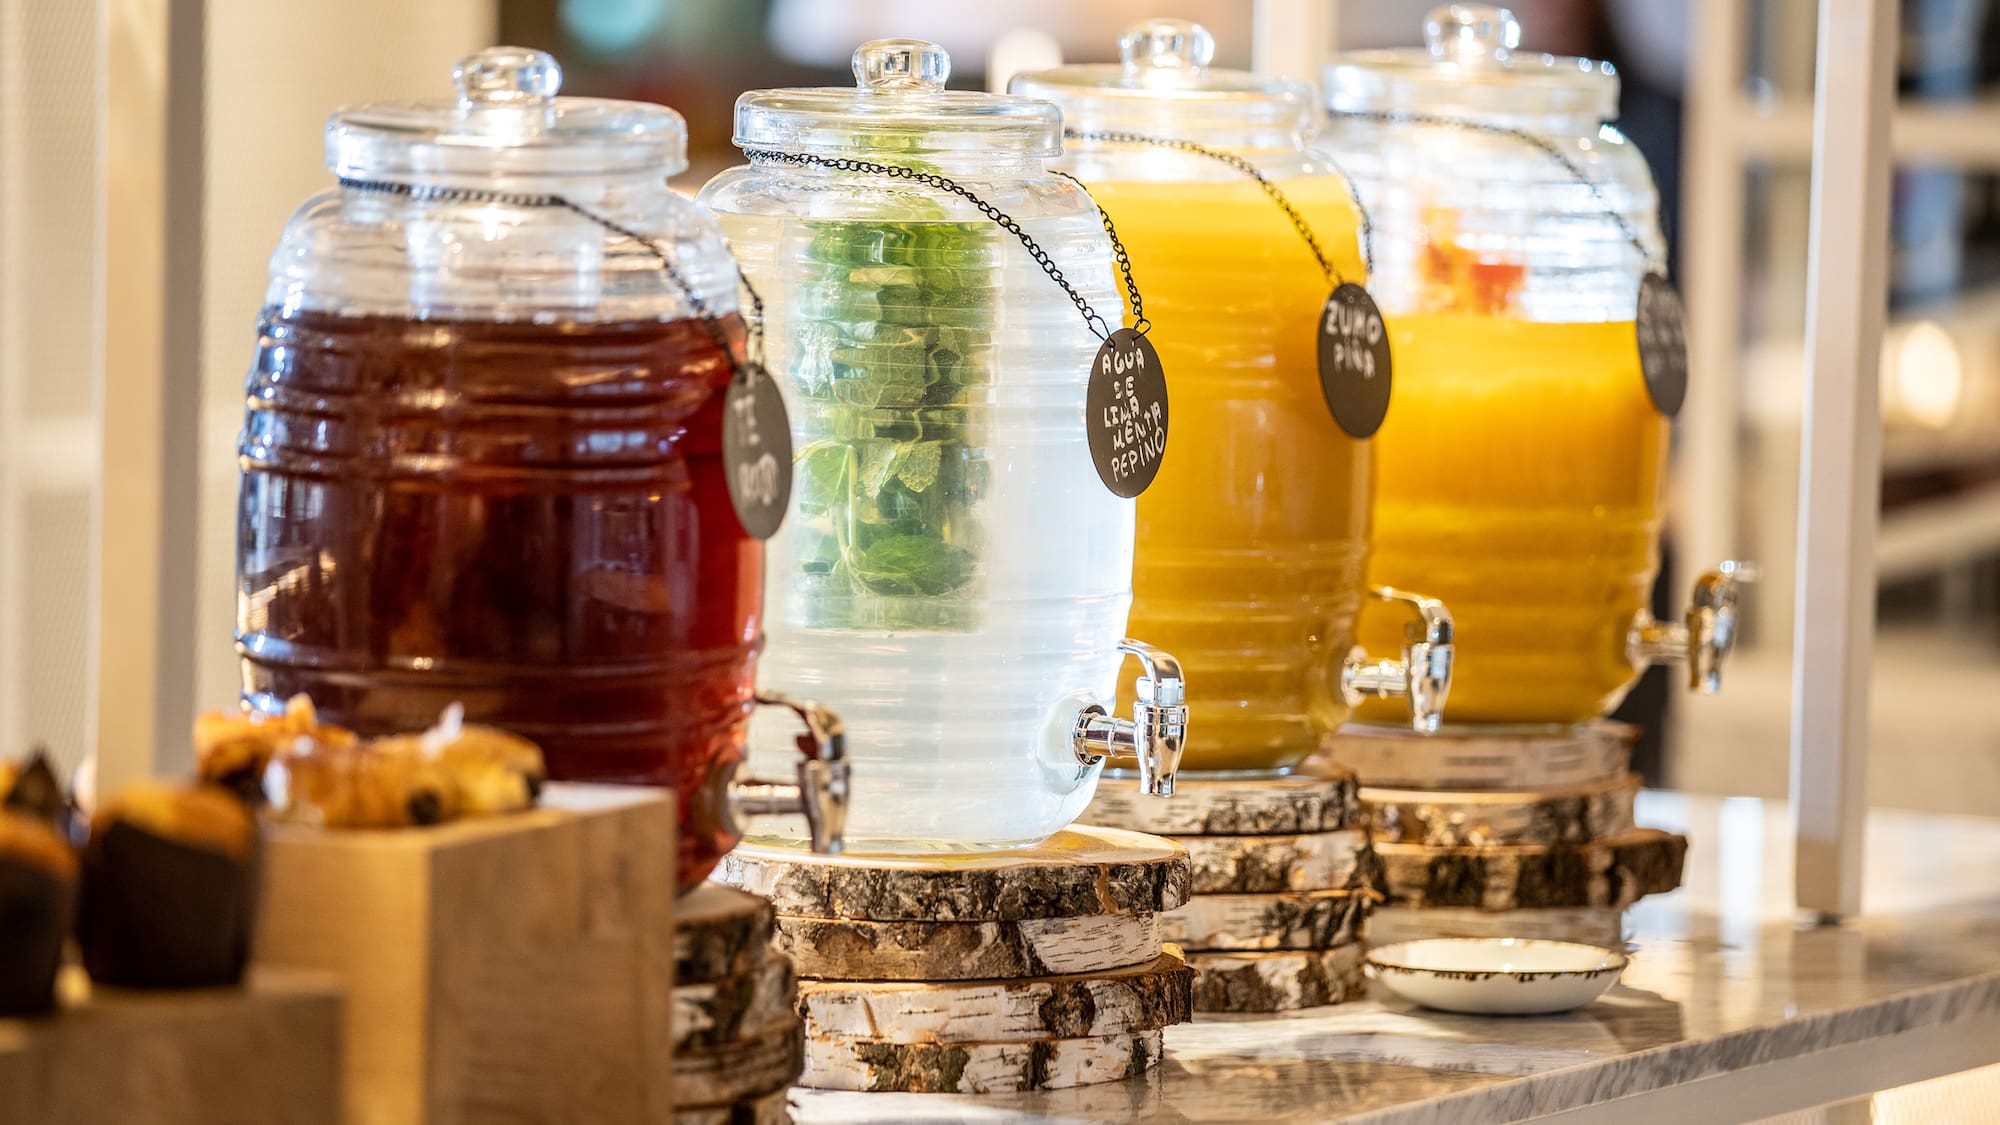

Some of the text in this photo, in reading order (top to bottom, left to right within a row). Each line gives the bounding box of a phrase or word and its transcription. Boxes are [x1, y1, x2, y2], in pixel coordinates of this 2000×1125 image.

[1325, 300, 1382, 345] ZUMO
[1102, 348, 1145, 375] AGUA
[1103, 396, 1140, 427] LIMA
[1113, 401, 1162, 450] MENTA
[1111, 426, 1165, 482] PEPINO
